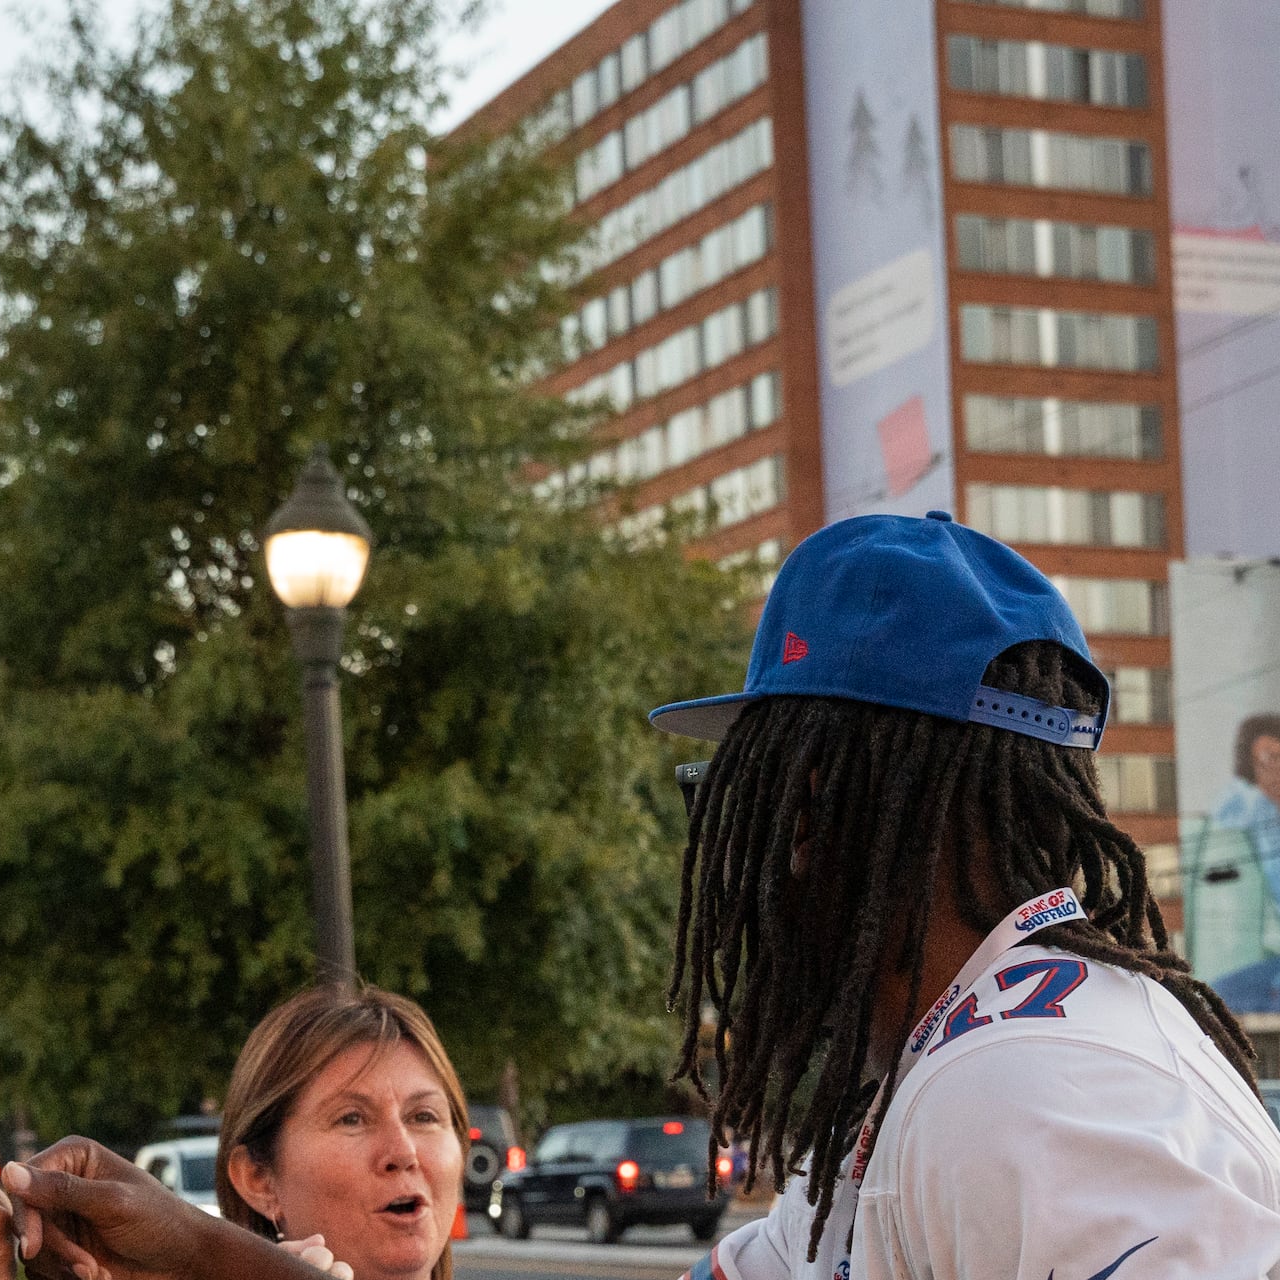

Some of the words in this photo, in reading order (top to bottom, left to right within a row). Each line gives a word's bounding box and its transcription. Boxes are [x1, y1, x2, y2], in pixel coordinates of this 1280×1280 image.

[1015, 895, 1077, 932] BUFFALO
[1018, 899, 1049, 920] FANS
[1048, 890, 1065, 907] OF
[911, 984, 960, 1053] BUFFALO
[913, 1010, 935, 1041] FANS
[935, 990, 950, 1010] OF
